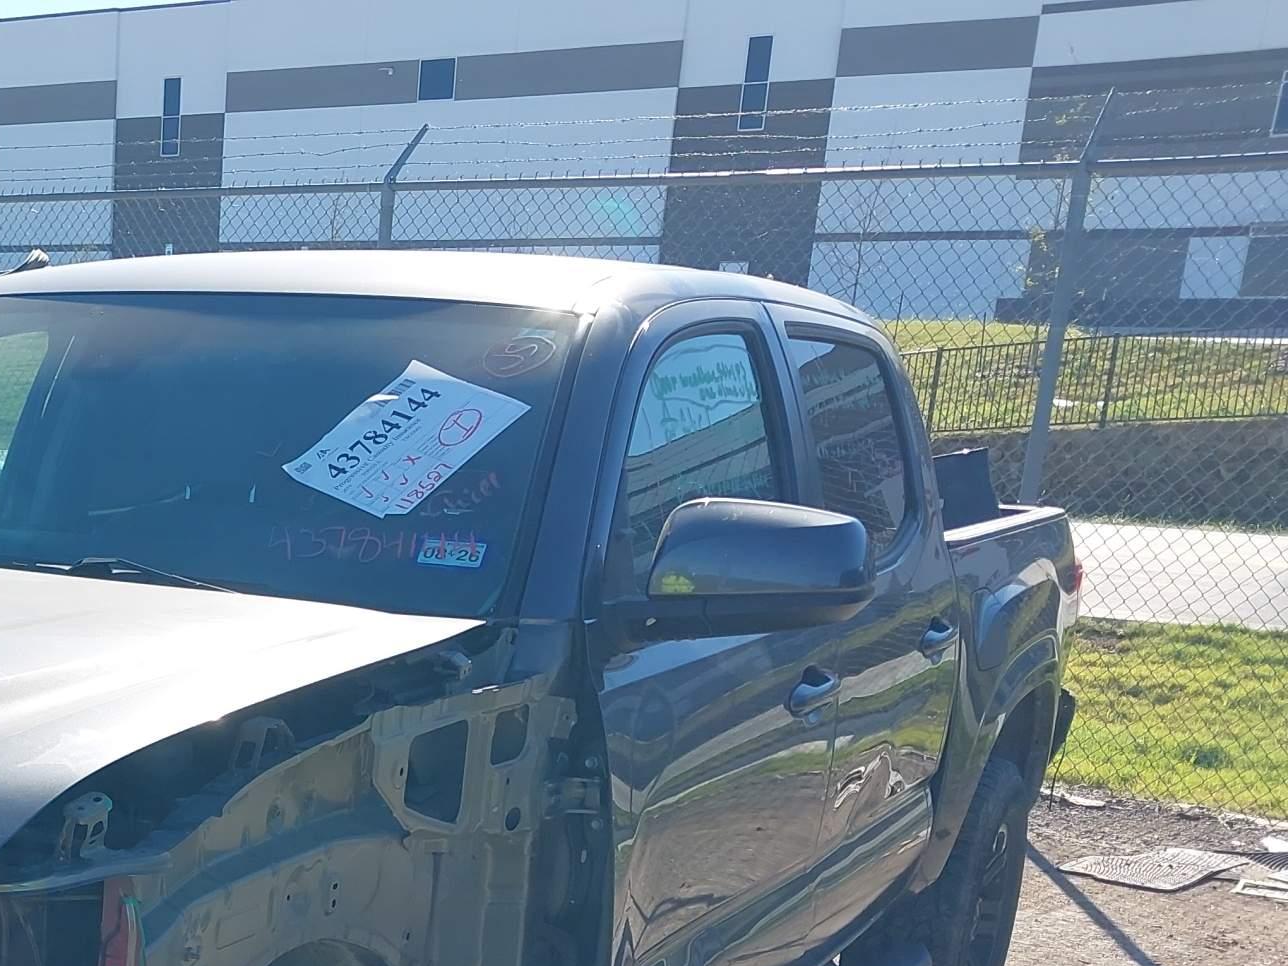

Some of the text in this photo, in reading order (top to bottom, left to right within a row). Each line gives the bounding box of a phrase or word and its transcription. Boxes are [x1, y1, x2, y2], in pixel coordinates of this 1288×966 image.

[328, 388, 441, 478] 43784144
[395, 463, 453, 509] 118527
[455, 547, 480, 562] 26
